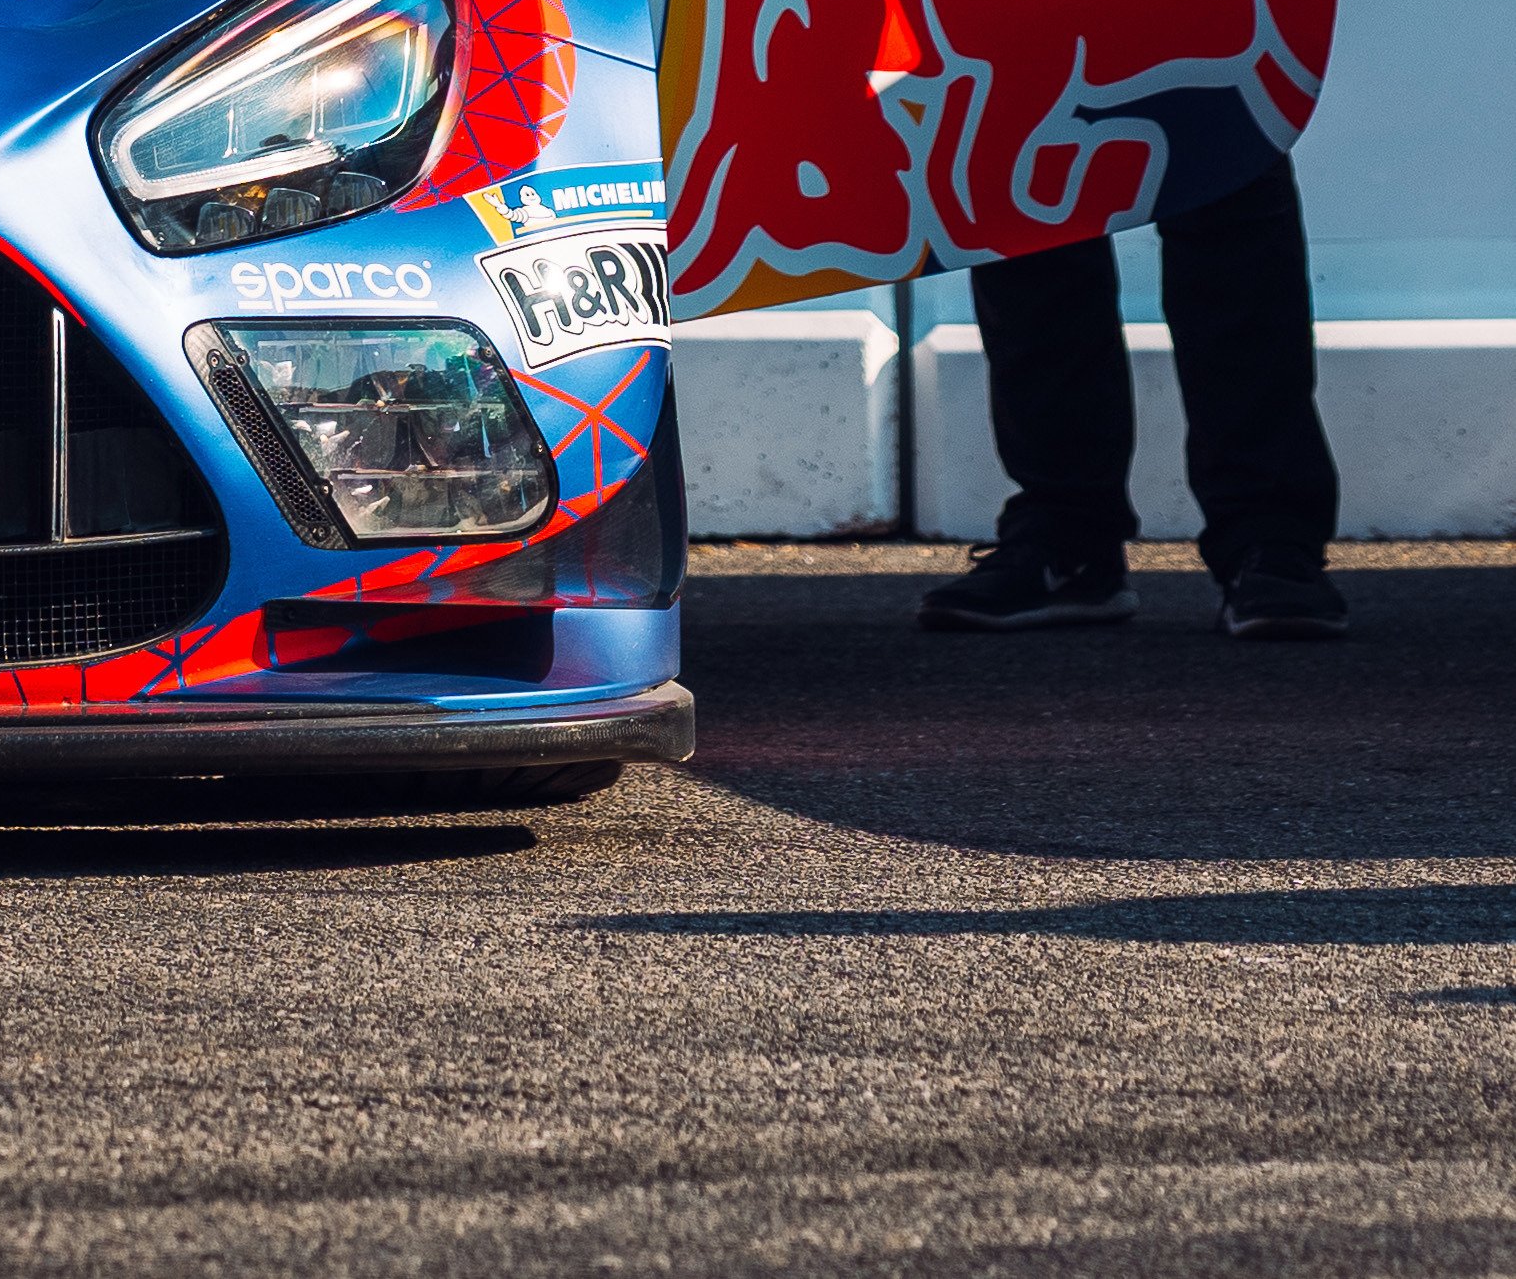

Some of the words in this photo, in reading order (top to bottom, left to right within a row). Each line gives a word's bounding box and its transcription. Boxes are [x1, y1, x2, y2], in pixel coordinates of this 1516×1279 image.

[552, 181, 667, 211] MICHELIN
[230, 262, 433, 313] sparco
[503, 249, 641, 338] H&R
